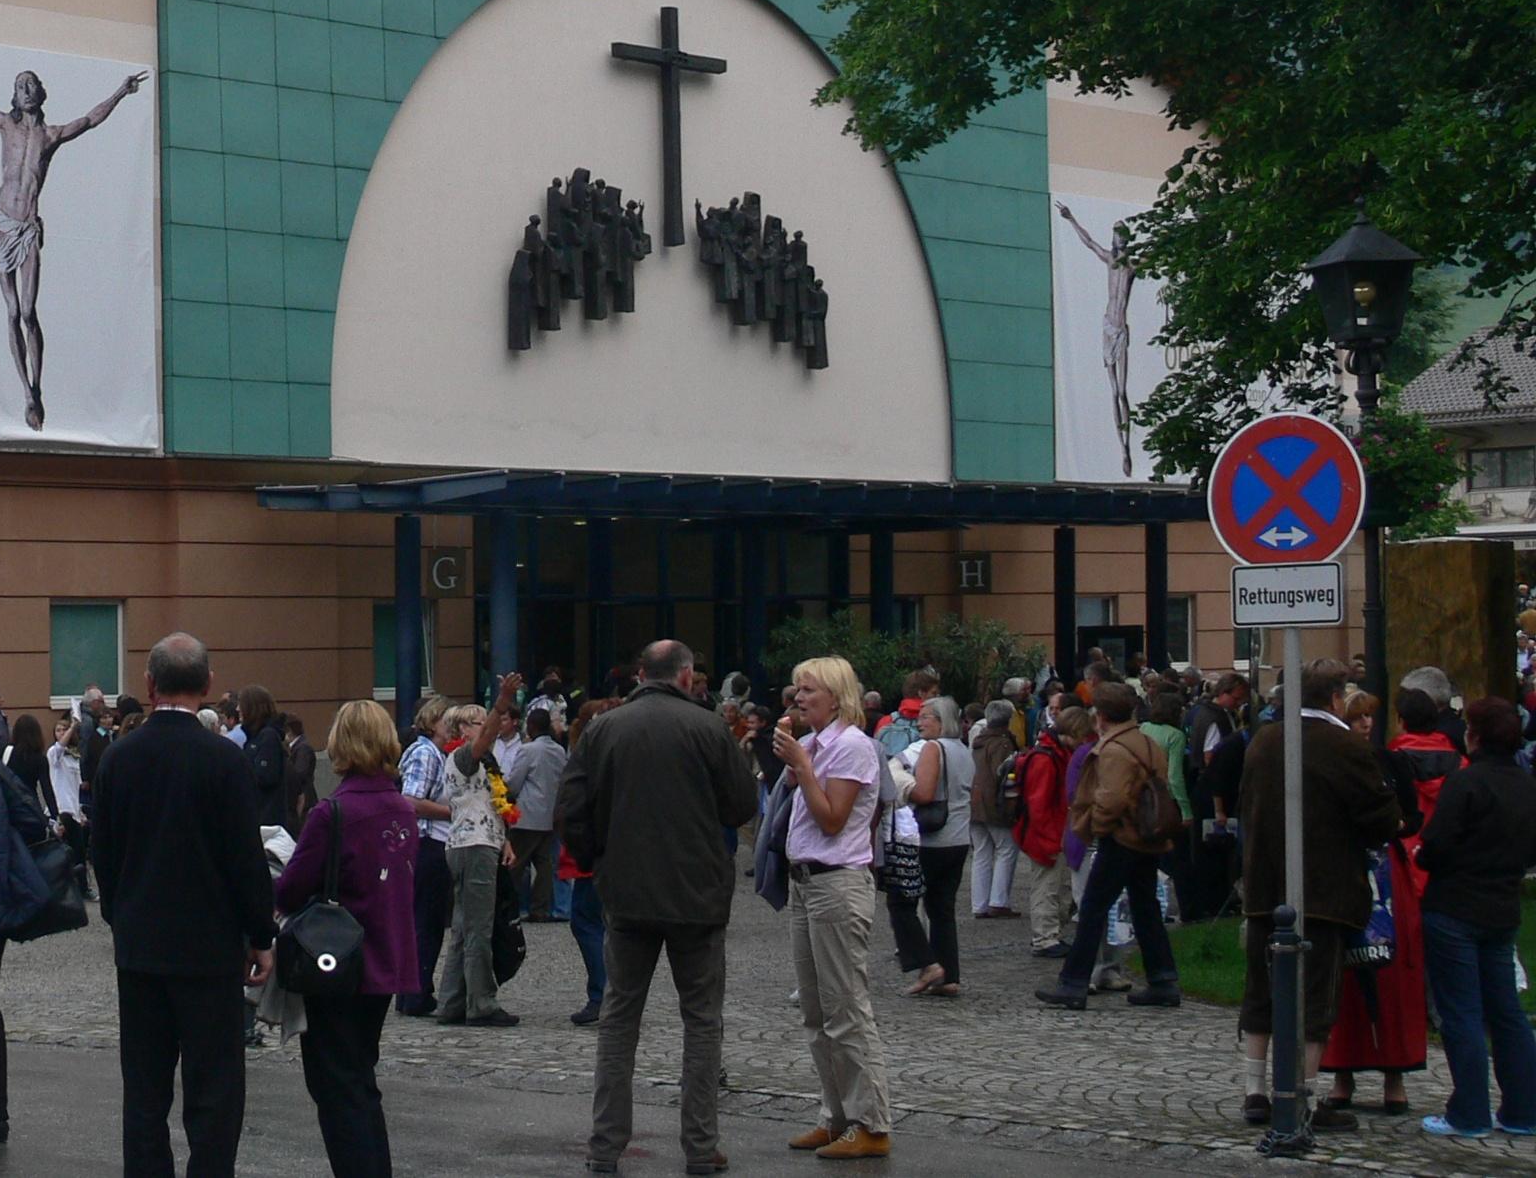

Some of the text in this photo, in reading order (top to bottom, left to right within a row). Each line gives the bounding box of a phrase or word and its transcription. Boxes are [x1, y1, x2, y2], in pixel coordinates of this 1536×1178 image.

[432, 556, 458, 590] G
[959, 560, 985, 588] H
[1238, 587, 1335, 608] Rettungsweg
[1343, 944, 1391, 965] ATURN
